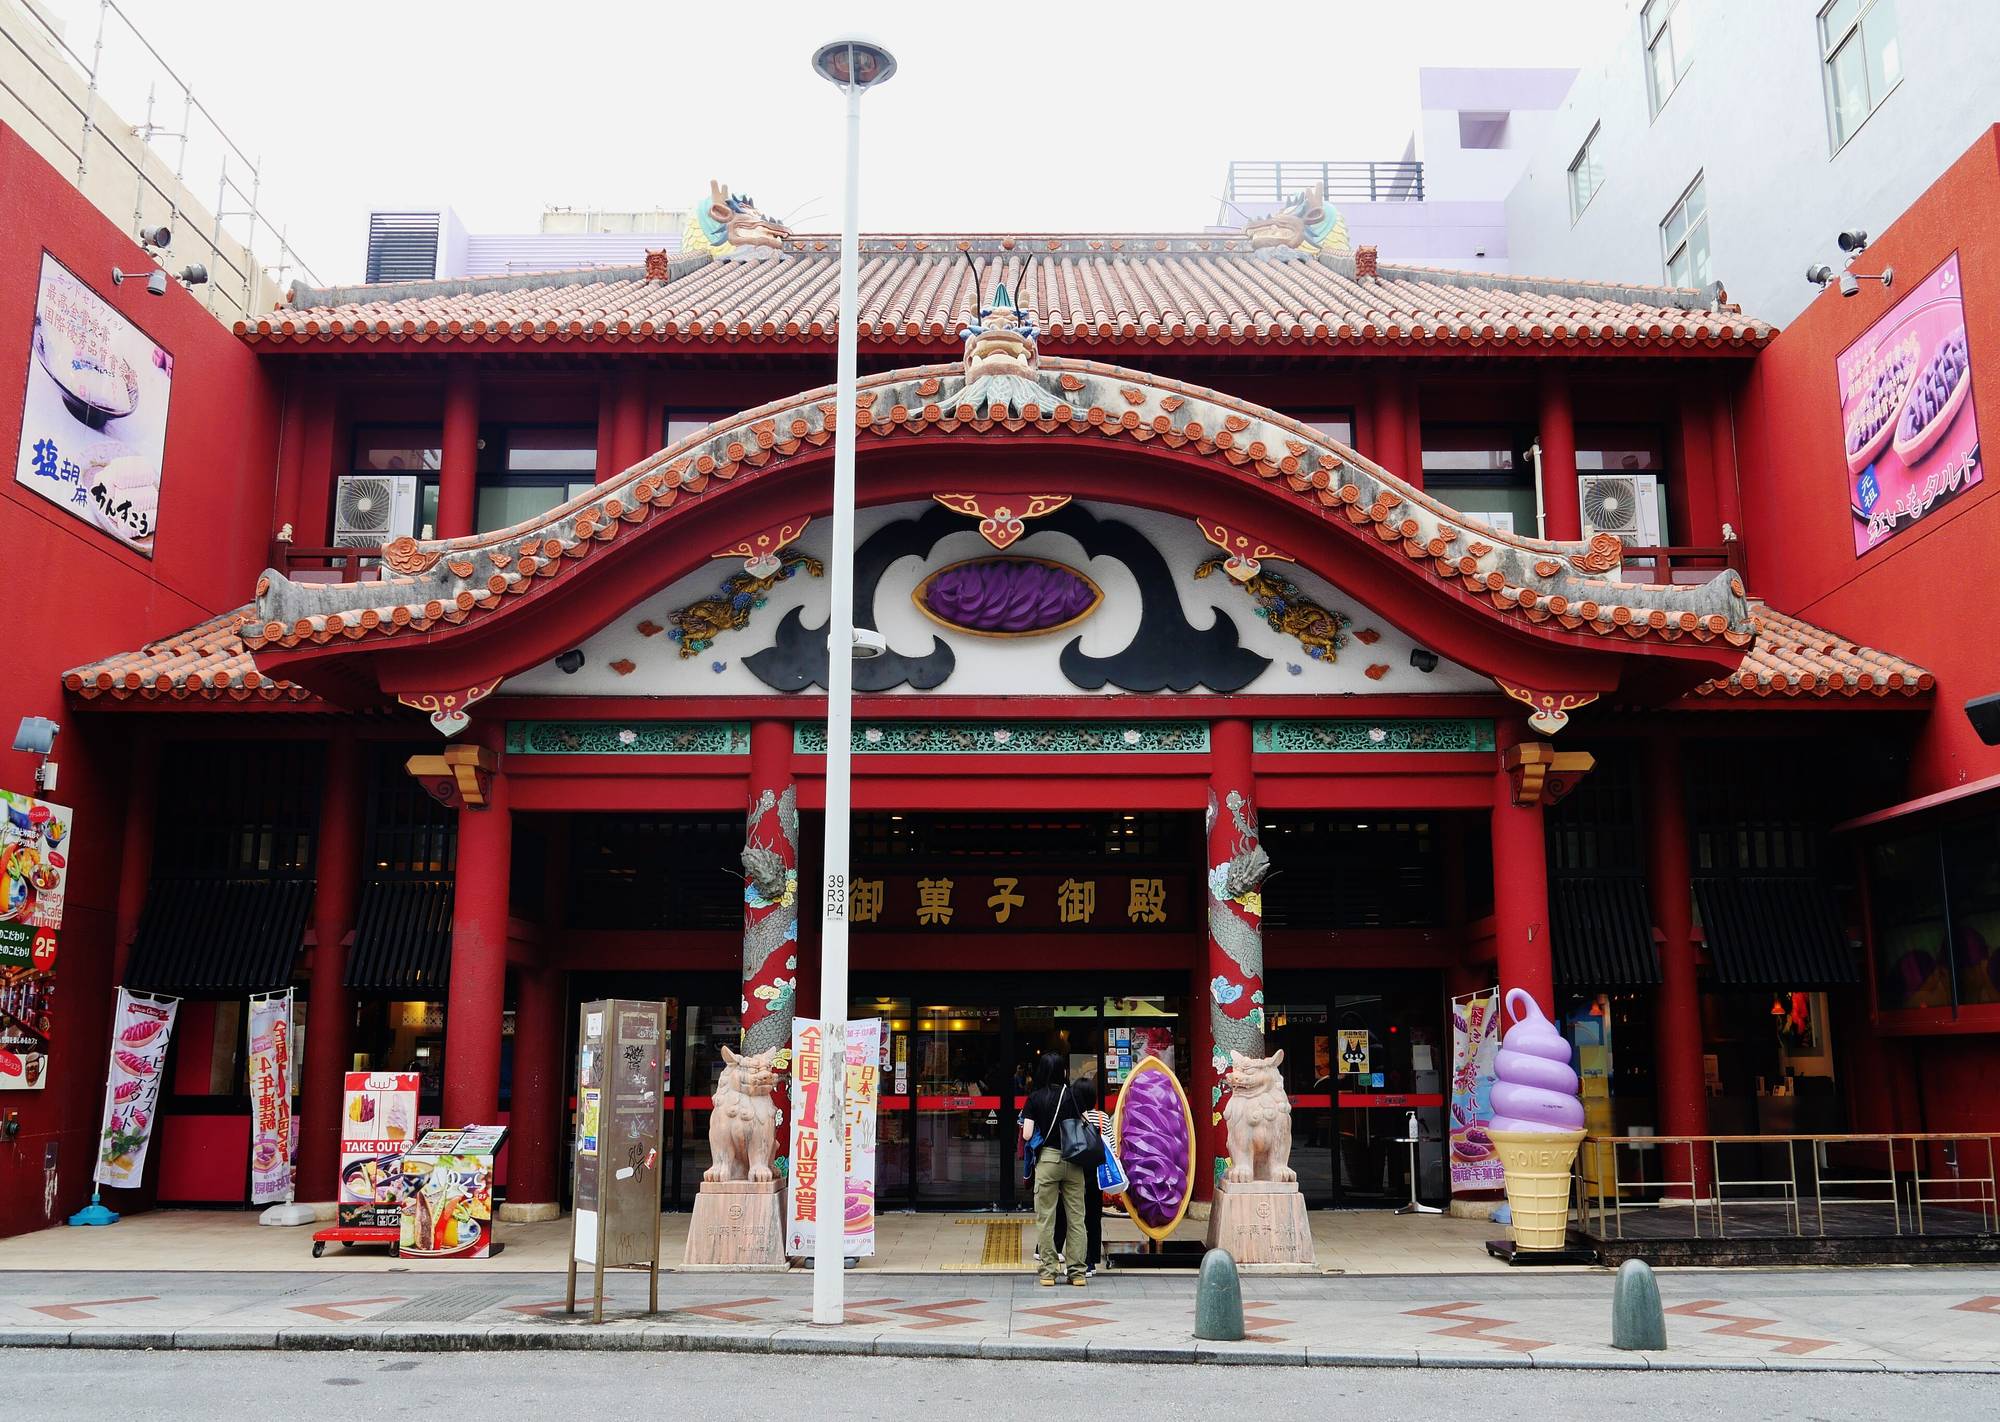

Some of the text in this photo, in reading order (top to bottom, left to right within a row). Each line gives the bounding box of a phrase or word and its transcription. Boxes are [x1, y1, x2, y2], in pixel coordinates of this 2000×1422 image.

[1861, 475, 1878, 509] 元祖
[1867, 452, 1976, 545] 紅いもタルト
[828, 874, 844, 888] 39
[826, 903, 844, 917] P4
[827, 889, 845, 903] R3
[849, 877, 1167, 925] 御菓子御殿
[34, 936, 56, 958] 2F
[141, 1028, 170, 1113] ハイビスカス
[121, 1055, 151, 1131] チーズタルト
[795, 1026, 820, 1222] 全国1位受賞
[345, 1141, 374, 1152] TAKE
[376, 1141, 400, 1152] OUT
[1508, 1150, 1560, 1168] HONEY
